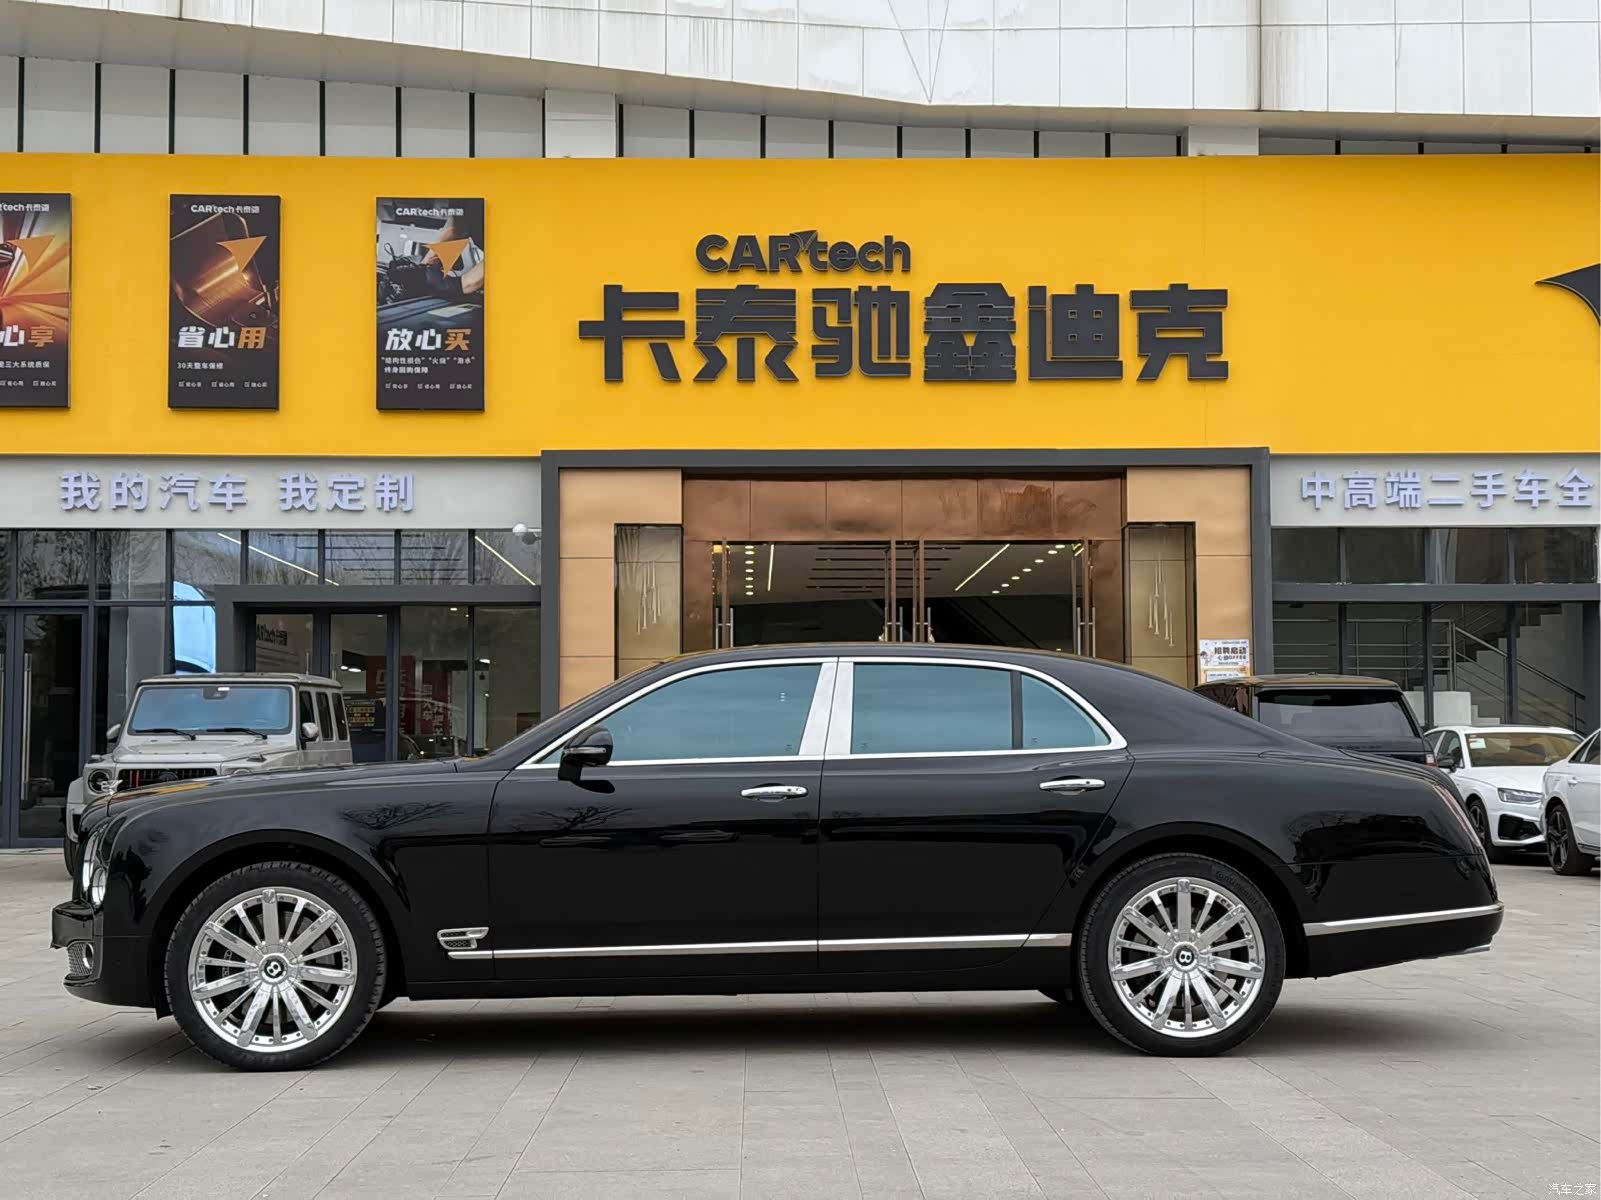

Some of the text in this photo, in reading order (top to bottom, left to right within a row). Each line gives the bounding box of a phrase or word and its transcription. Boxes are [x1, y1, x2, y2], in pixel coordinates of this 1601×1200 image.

[190, 204, 234, 213] CARtech
[395, 207, 439, 216] CARtech
[695, 231, 912, 272] CARtech
[178, 326, 267, 349] 省心用
[385, 328, 472, 351] 放心买
[579, 283, 1229, 383] 卡泰驰鑫迪克
[60, 471, 416, 512] 我的汽车 我定制
[1300, 467, 1594, 510] 中高端二手车全
